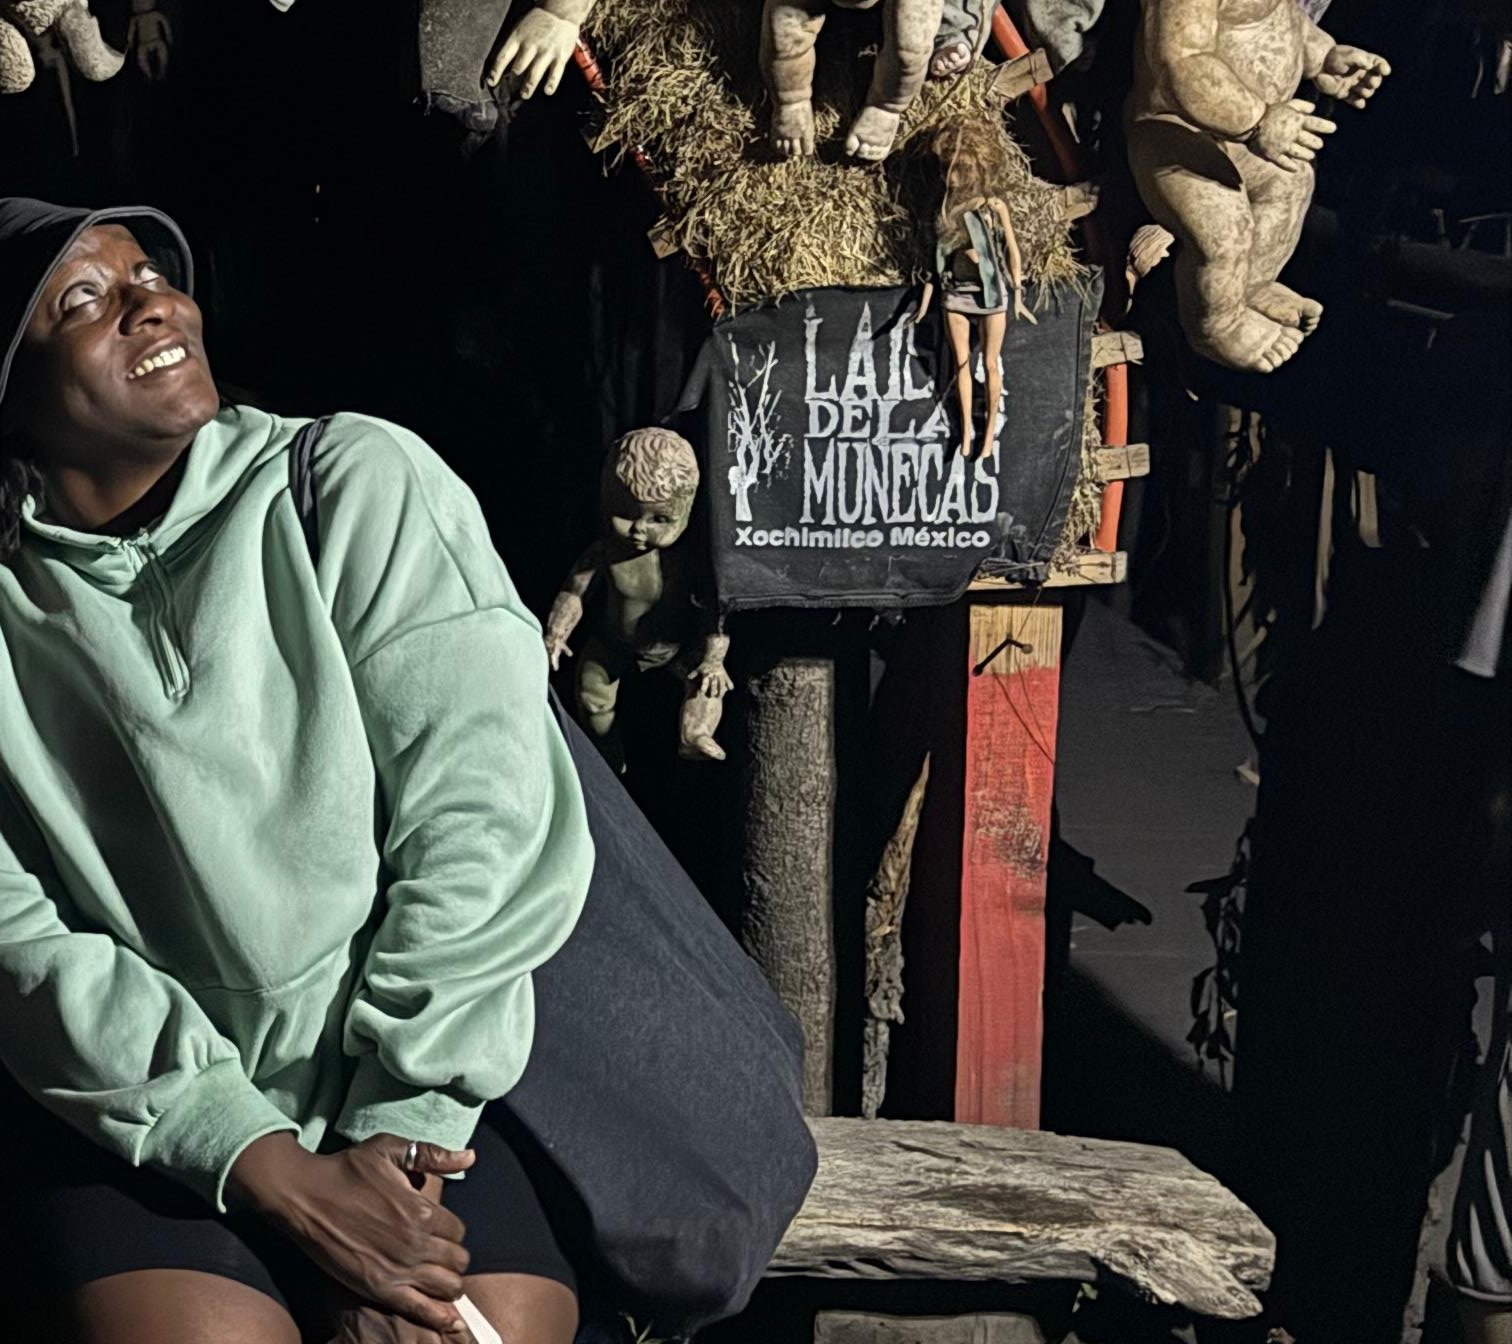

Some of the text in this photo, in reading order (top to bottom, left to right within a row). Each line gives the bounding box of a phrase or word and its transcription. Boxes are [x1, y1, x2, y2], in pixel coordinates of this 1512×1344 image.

[803, 400, 872, 438] DE
[735, 526, 991, 548] Xochimilco México
